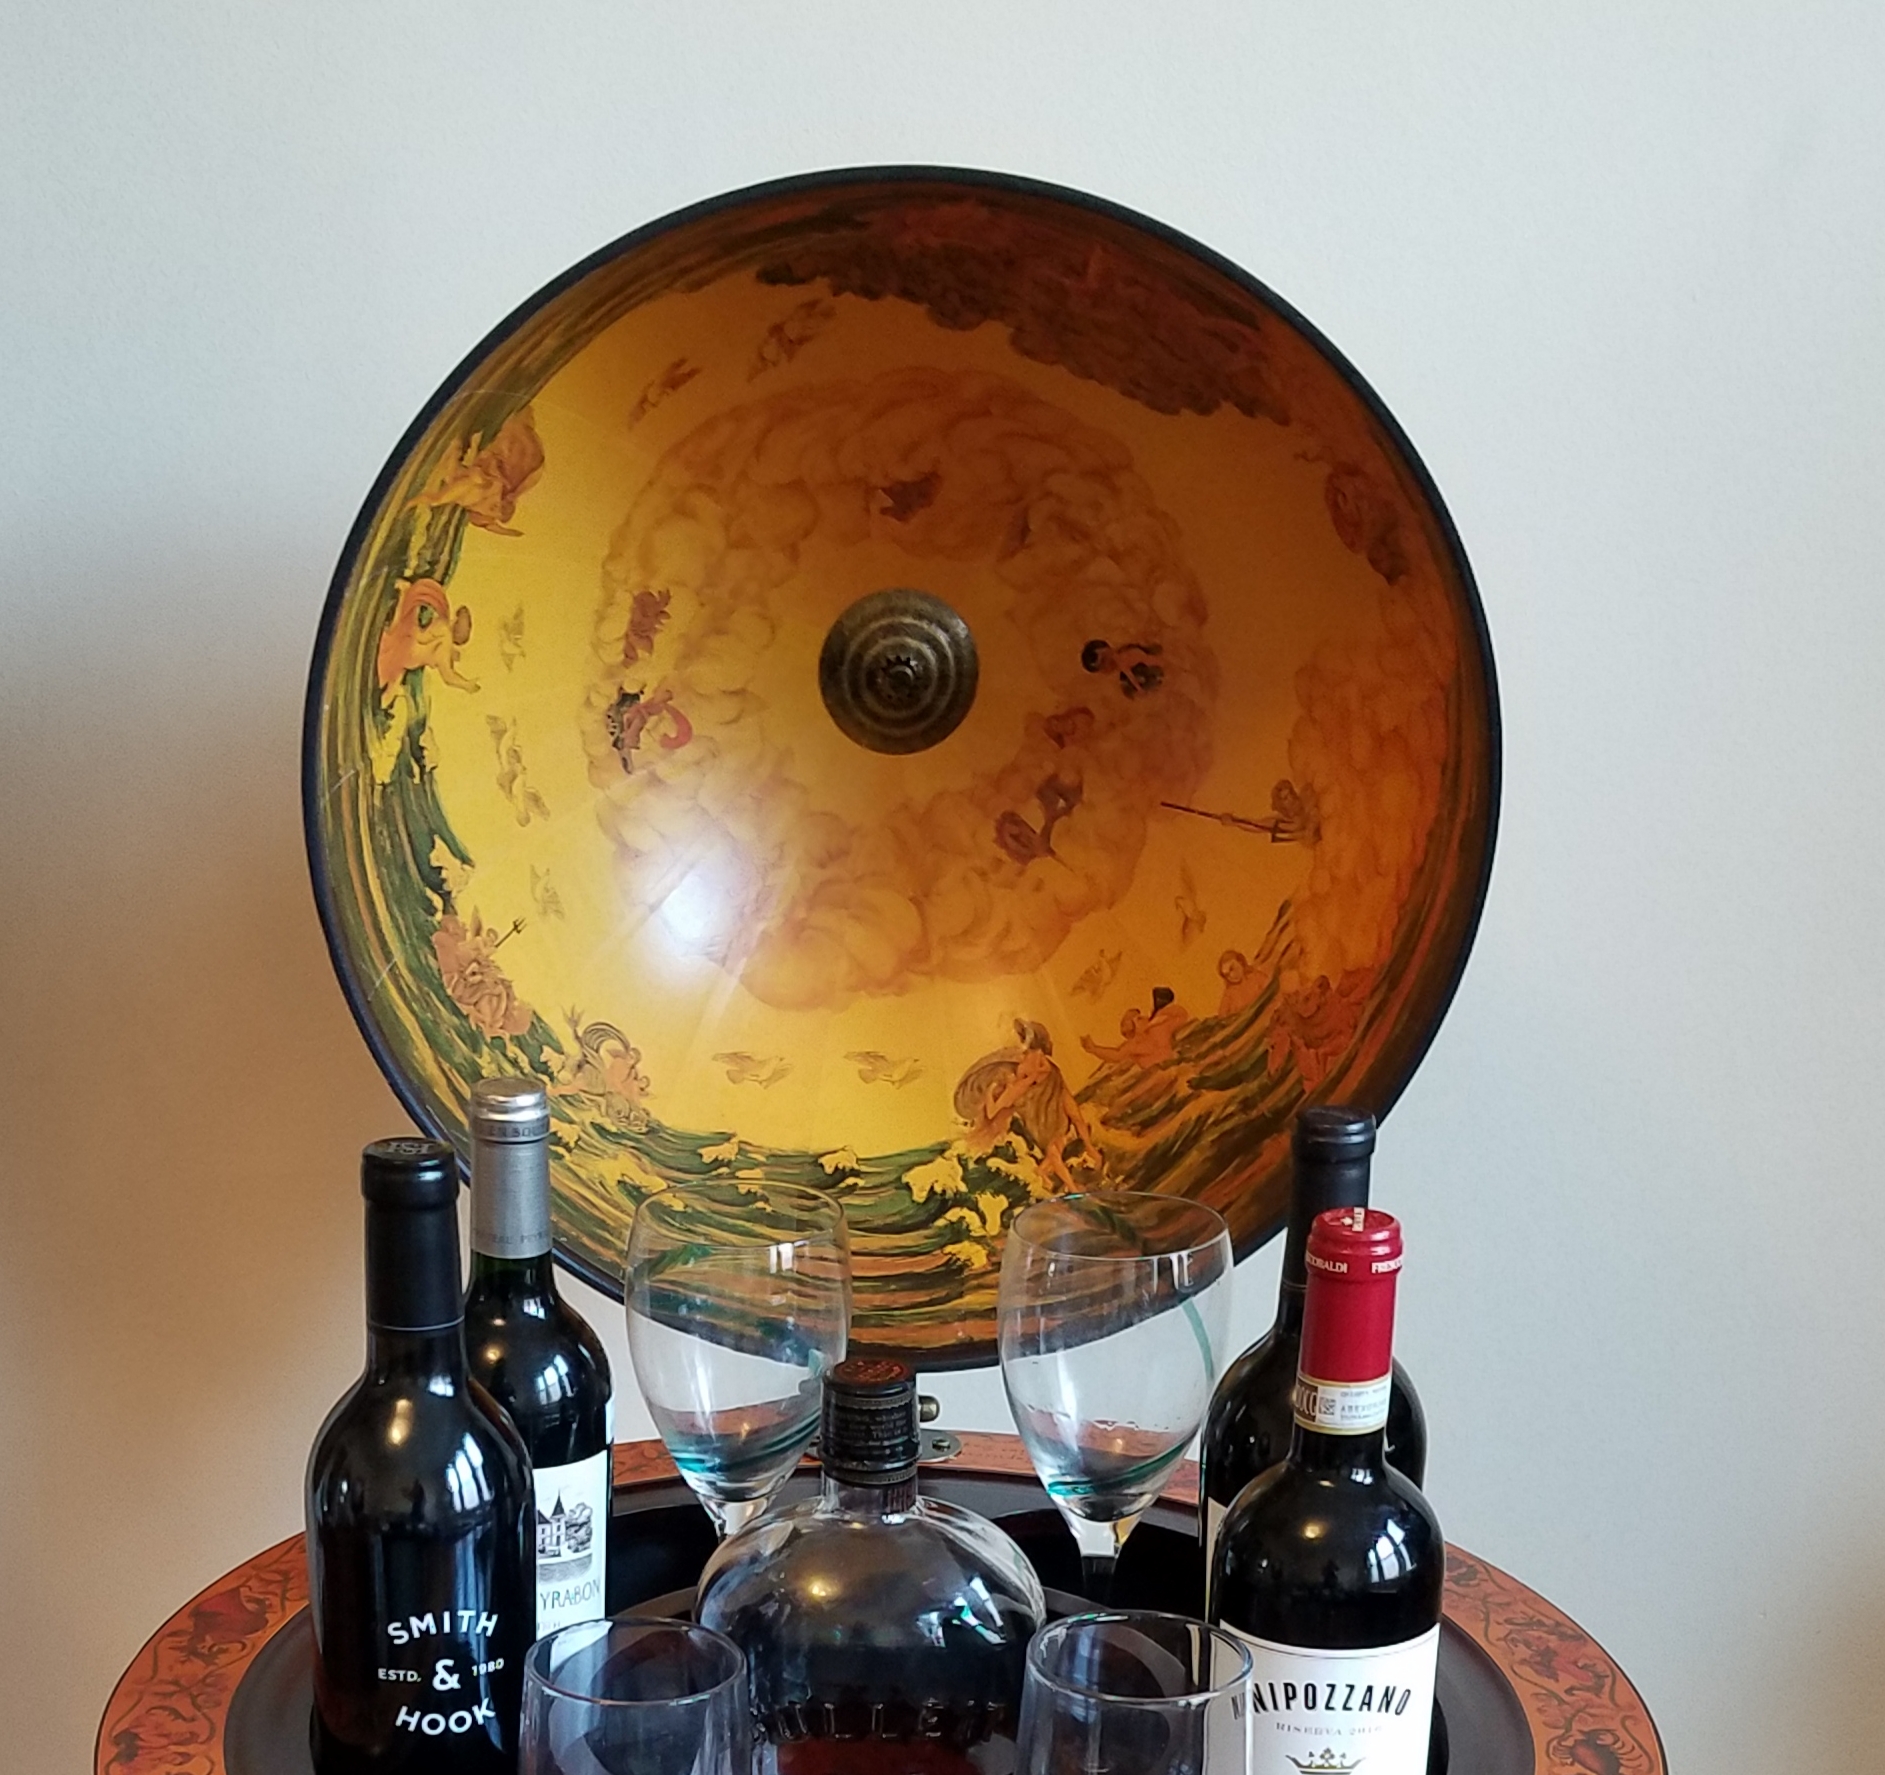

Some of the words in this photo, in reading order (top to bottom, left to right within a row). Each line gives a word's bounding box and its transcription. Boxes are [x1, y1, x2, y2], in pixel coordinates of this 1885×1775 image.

[387, 1609, 498, 1645] SMITH
[432, 1658, 461, 1691] &
[395, 1697, 496, 1736] HOOK
